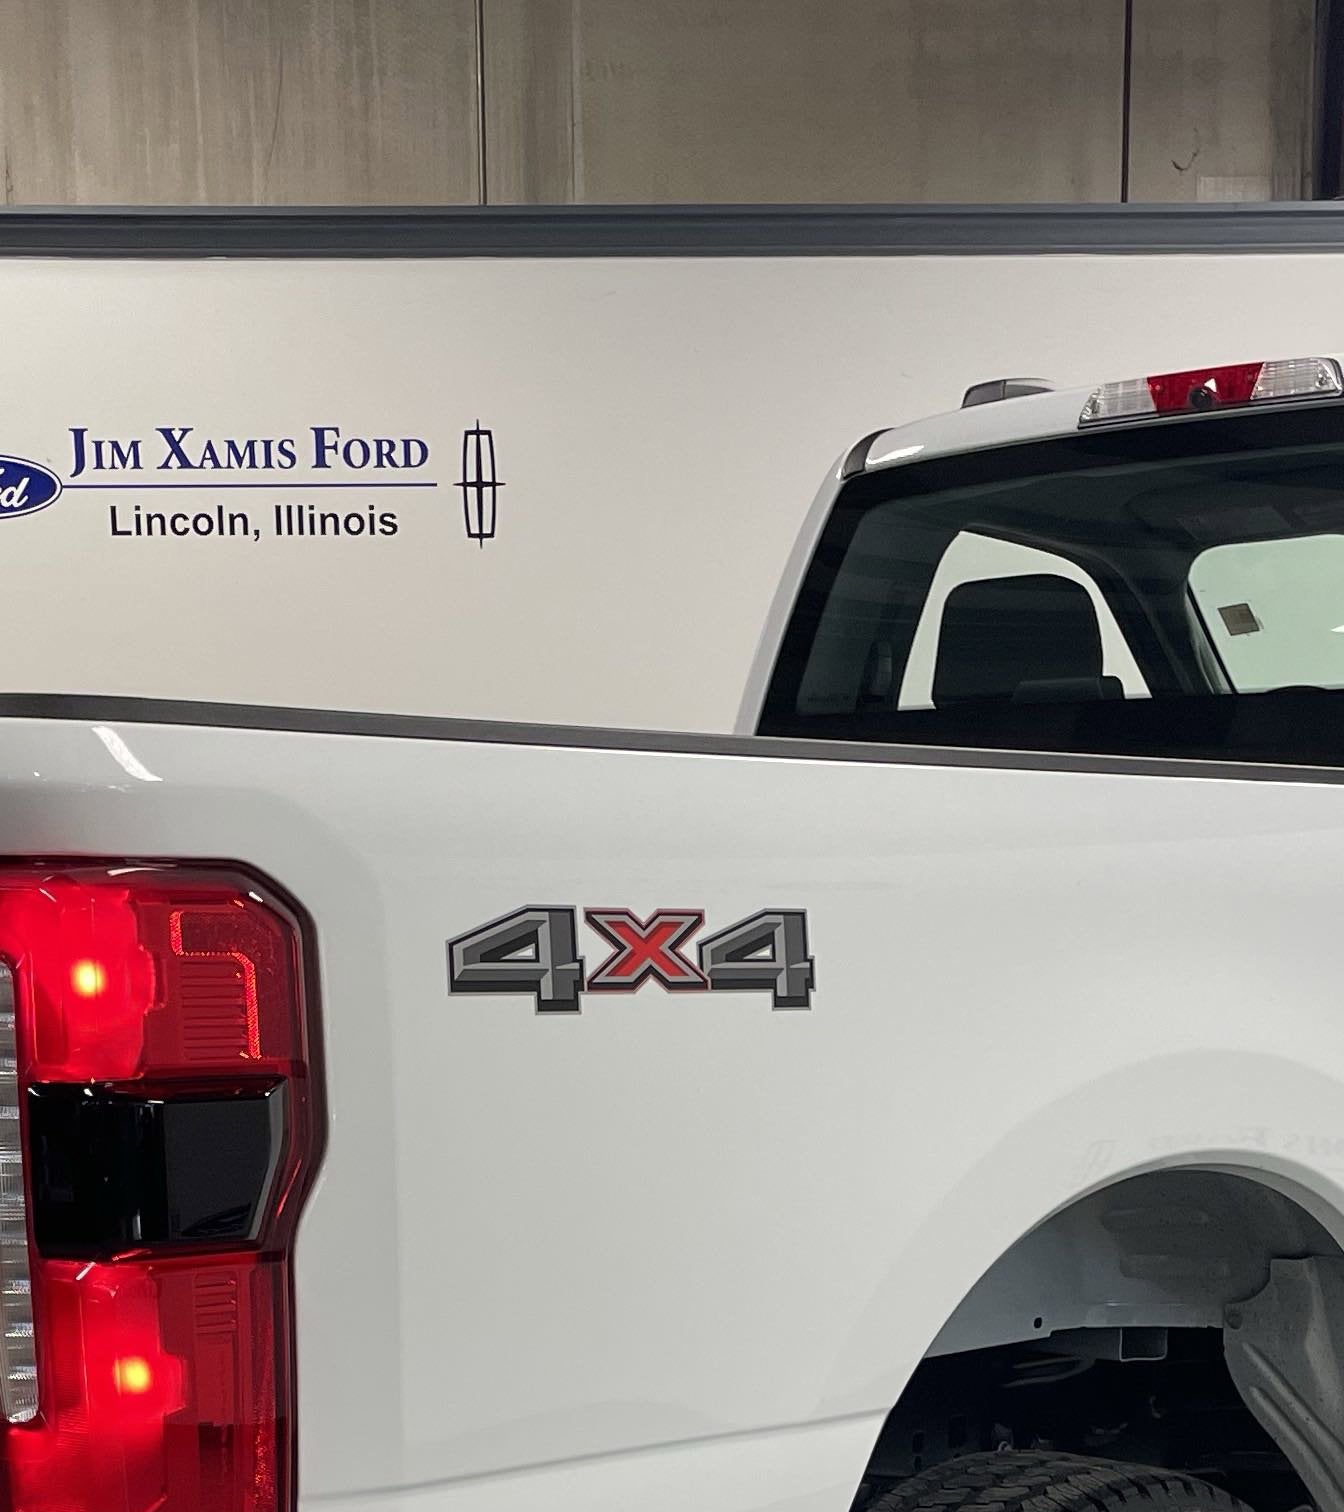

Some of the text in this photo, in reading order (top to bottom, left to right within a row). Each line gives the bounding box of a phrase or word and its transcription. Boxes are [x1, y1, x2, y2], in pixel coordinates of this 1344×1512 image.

[67, 426, 429, 479] JIM XAMIS FORD
[109, 505, 398, 541] Lincoln, Illinois
